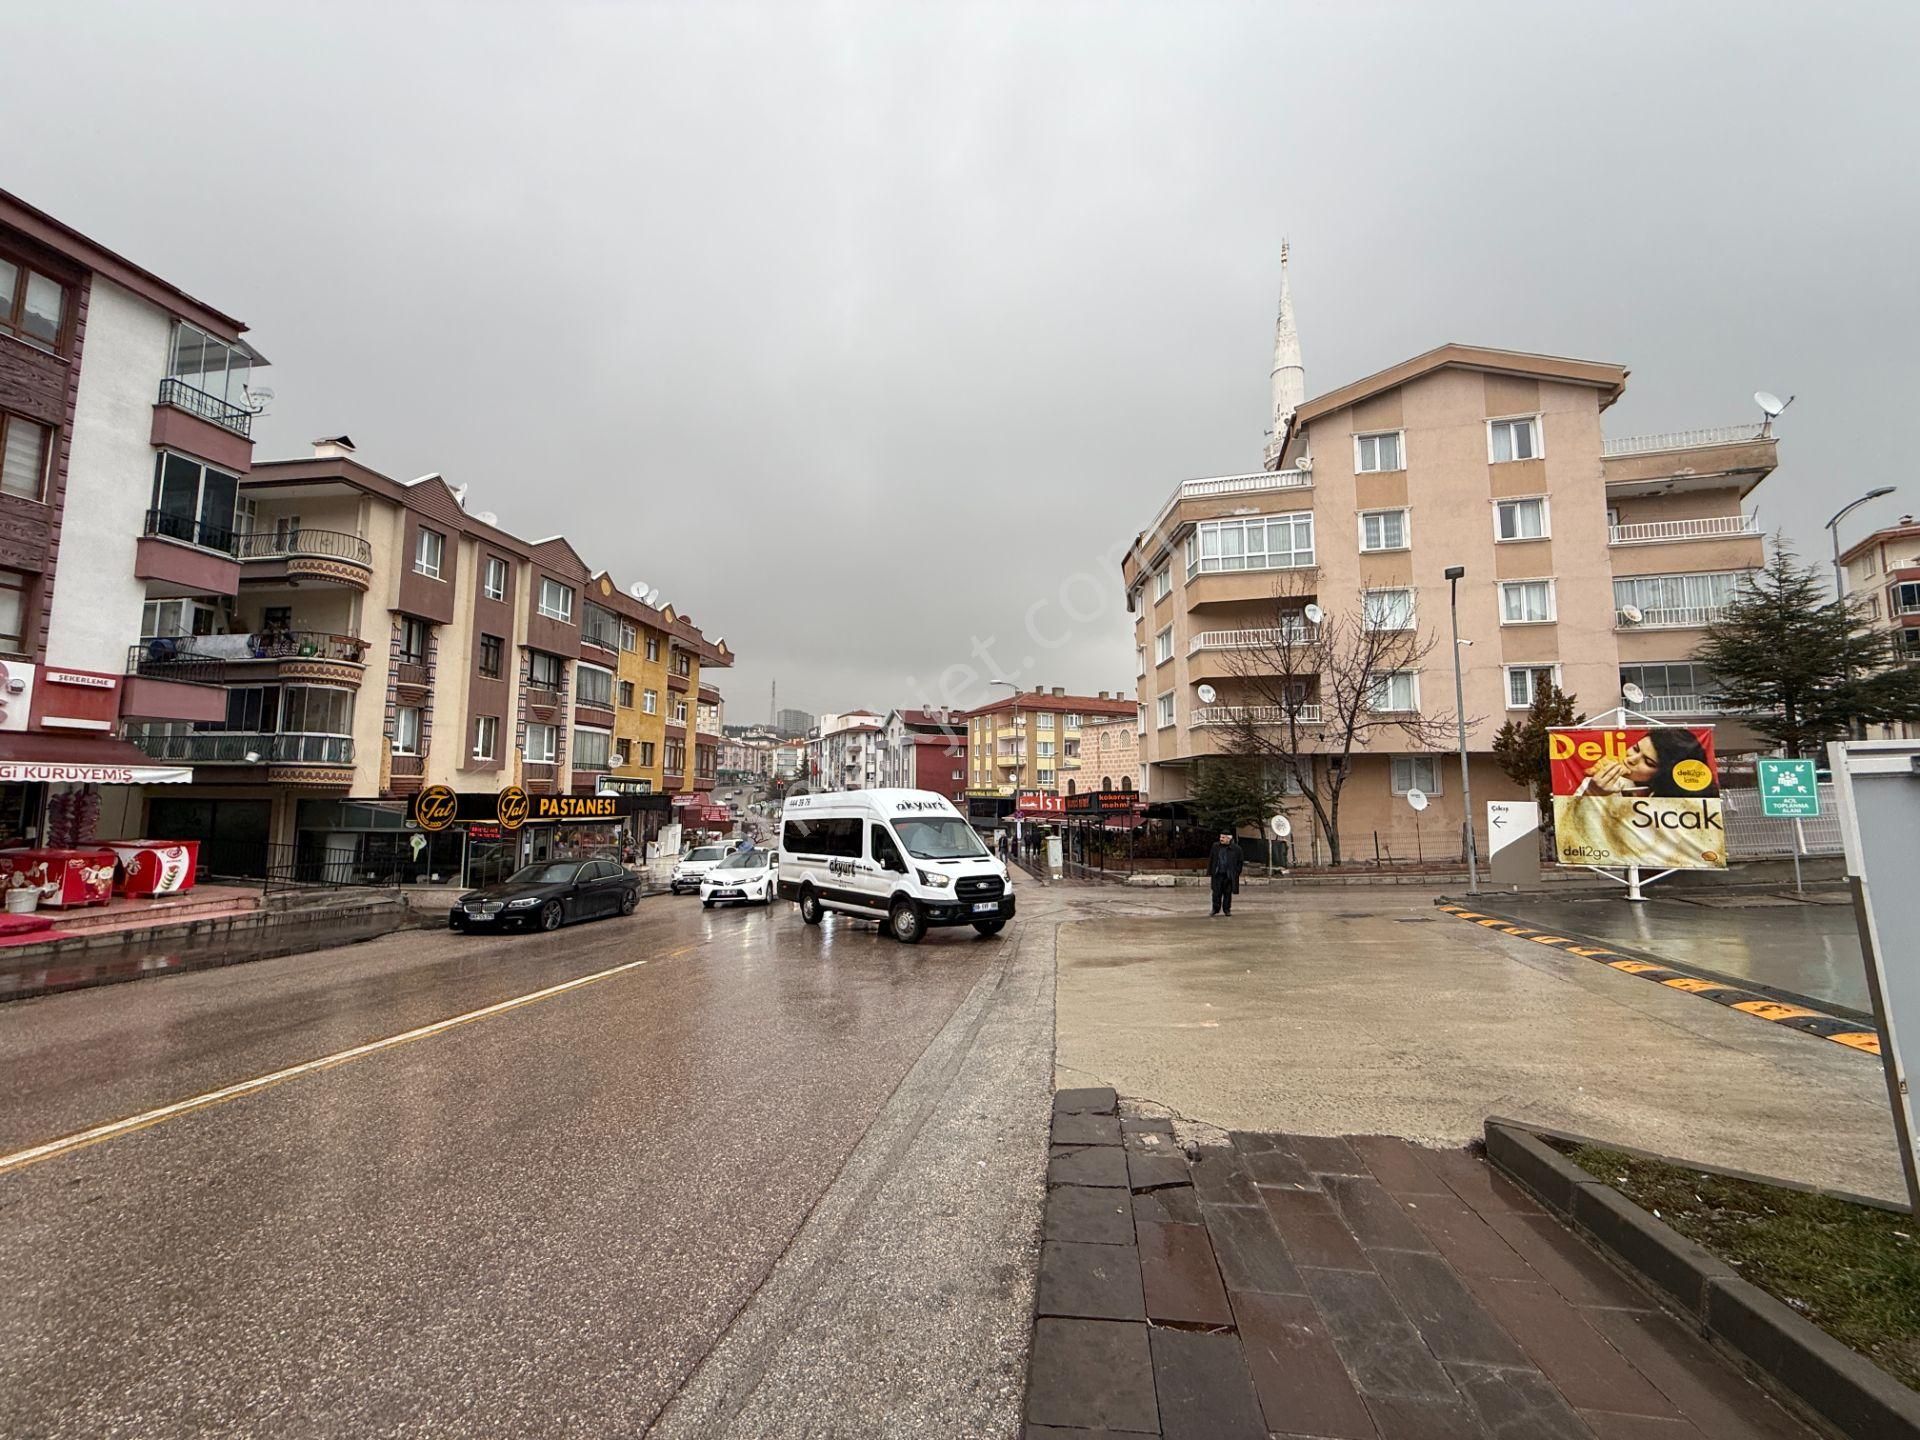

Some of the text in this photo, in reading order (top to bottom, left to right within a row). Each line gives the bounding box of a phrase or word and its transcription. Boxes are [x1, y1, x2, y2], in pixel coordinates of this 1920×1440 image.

[58, 674, 109, 686] ŞEKERLEME
[1549, 731, 1627, 762] Deli
[421, 795, 455, 819] Tat
[501, 795, 526, 819] Tat
[896, 800, 948, 811] akyurt
[1631, 799, 1723, 831] Sıcak
[1563, 845, 1610, 860] deli2go
[830, 857, 856, 878] akyurt
